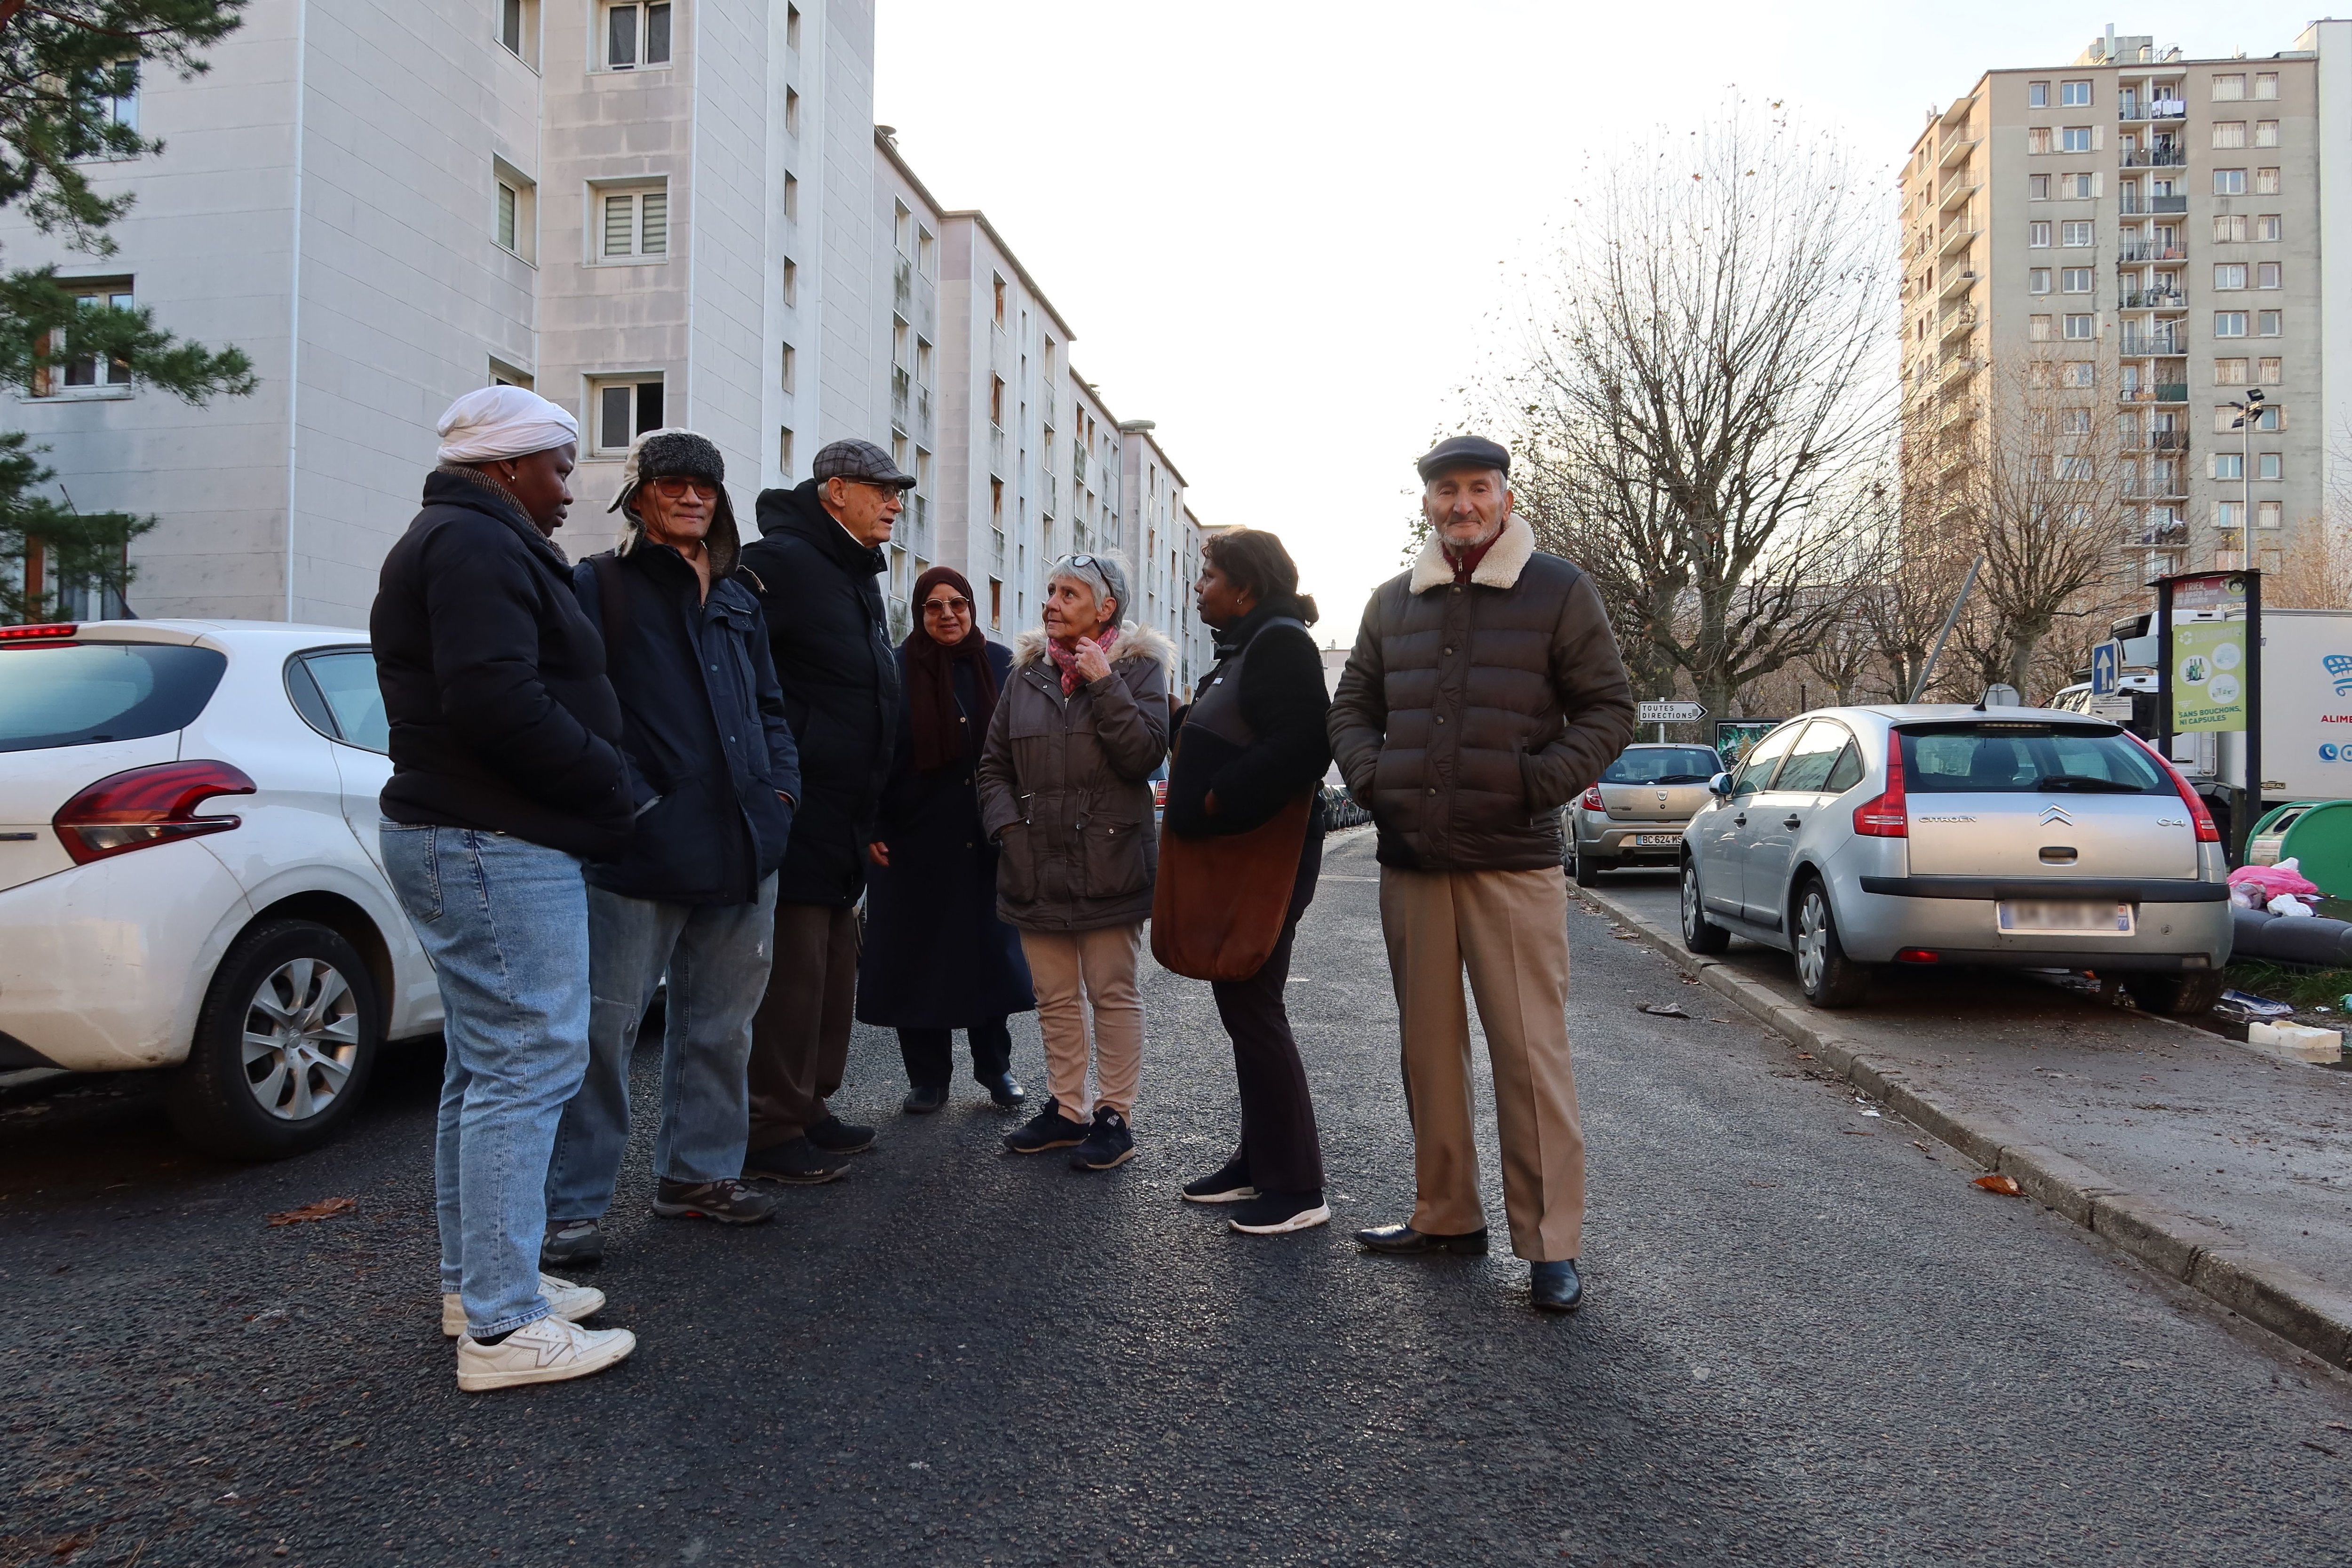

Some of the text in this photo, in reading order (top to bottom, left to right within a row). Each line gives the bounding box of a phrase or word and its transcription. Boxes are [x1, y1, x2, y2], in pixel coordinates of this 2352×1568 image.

[2199, 706, 2241, 715] BOUCHONS,
[2188, 715, 2226, 724] CAPSULES
[2156, 818, 2186, 827] C4
